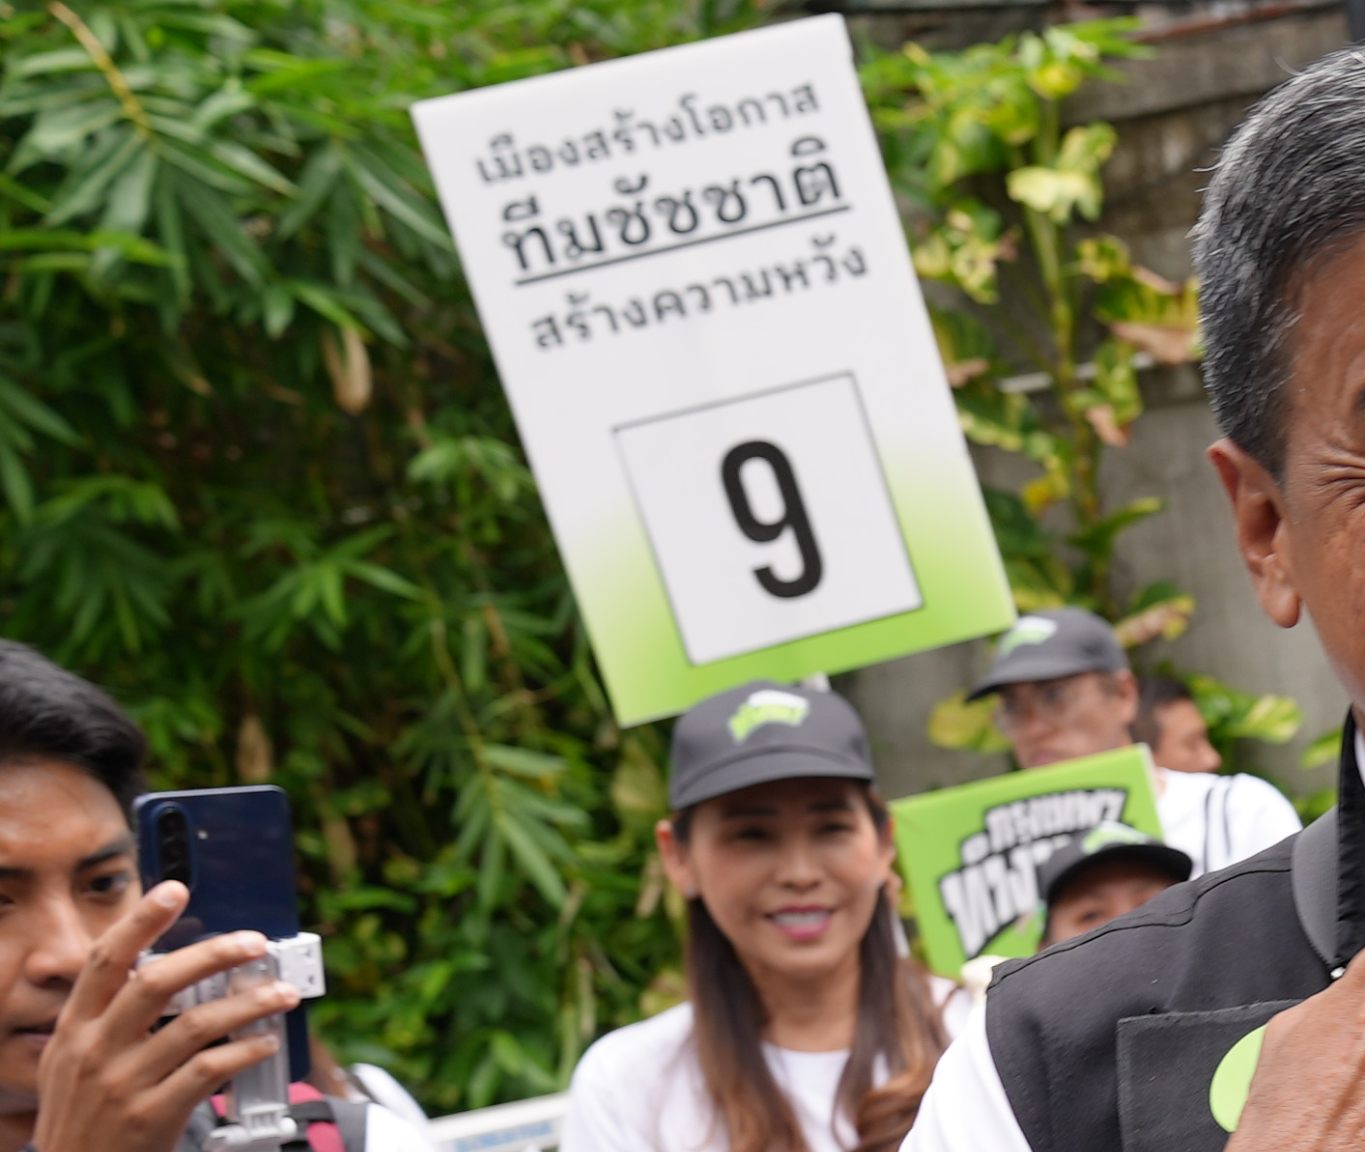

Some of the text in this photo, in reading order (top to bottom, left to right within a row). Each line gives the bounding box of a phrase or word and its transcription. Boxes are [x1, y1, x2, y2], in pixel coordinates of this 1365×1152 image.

[475, 81, 821, 185] เมืองสร้างโอกาส
[501, 134, 842, 272] ทีมชัชชาติ
[532, 232, 869, 349] สร้างความหวัง
[719, 438, 825, 601] 9
